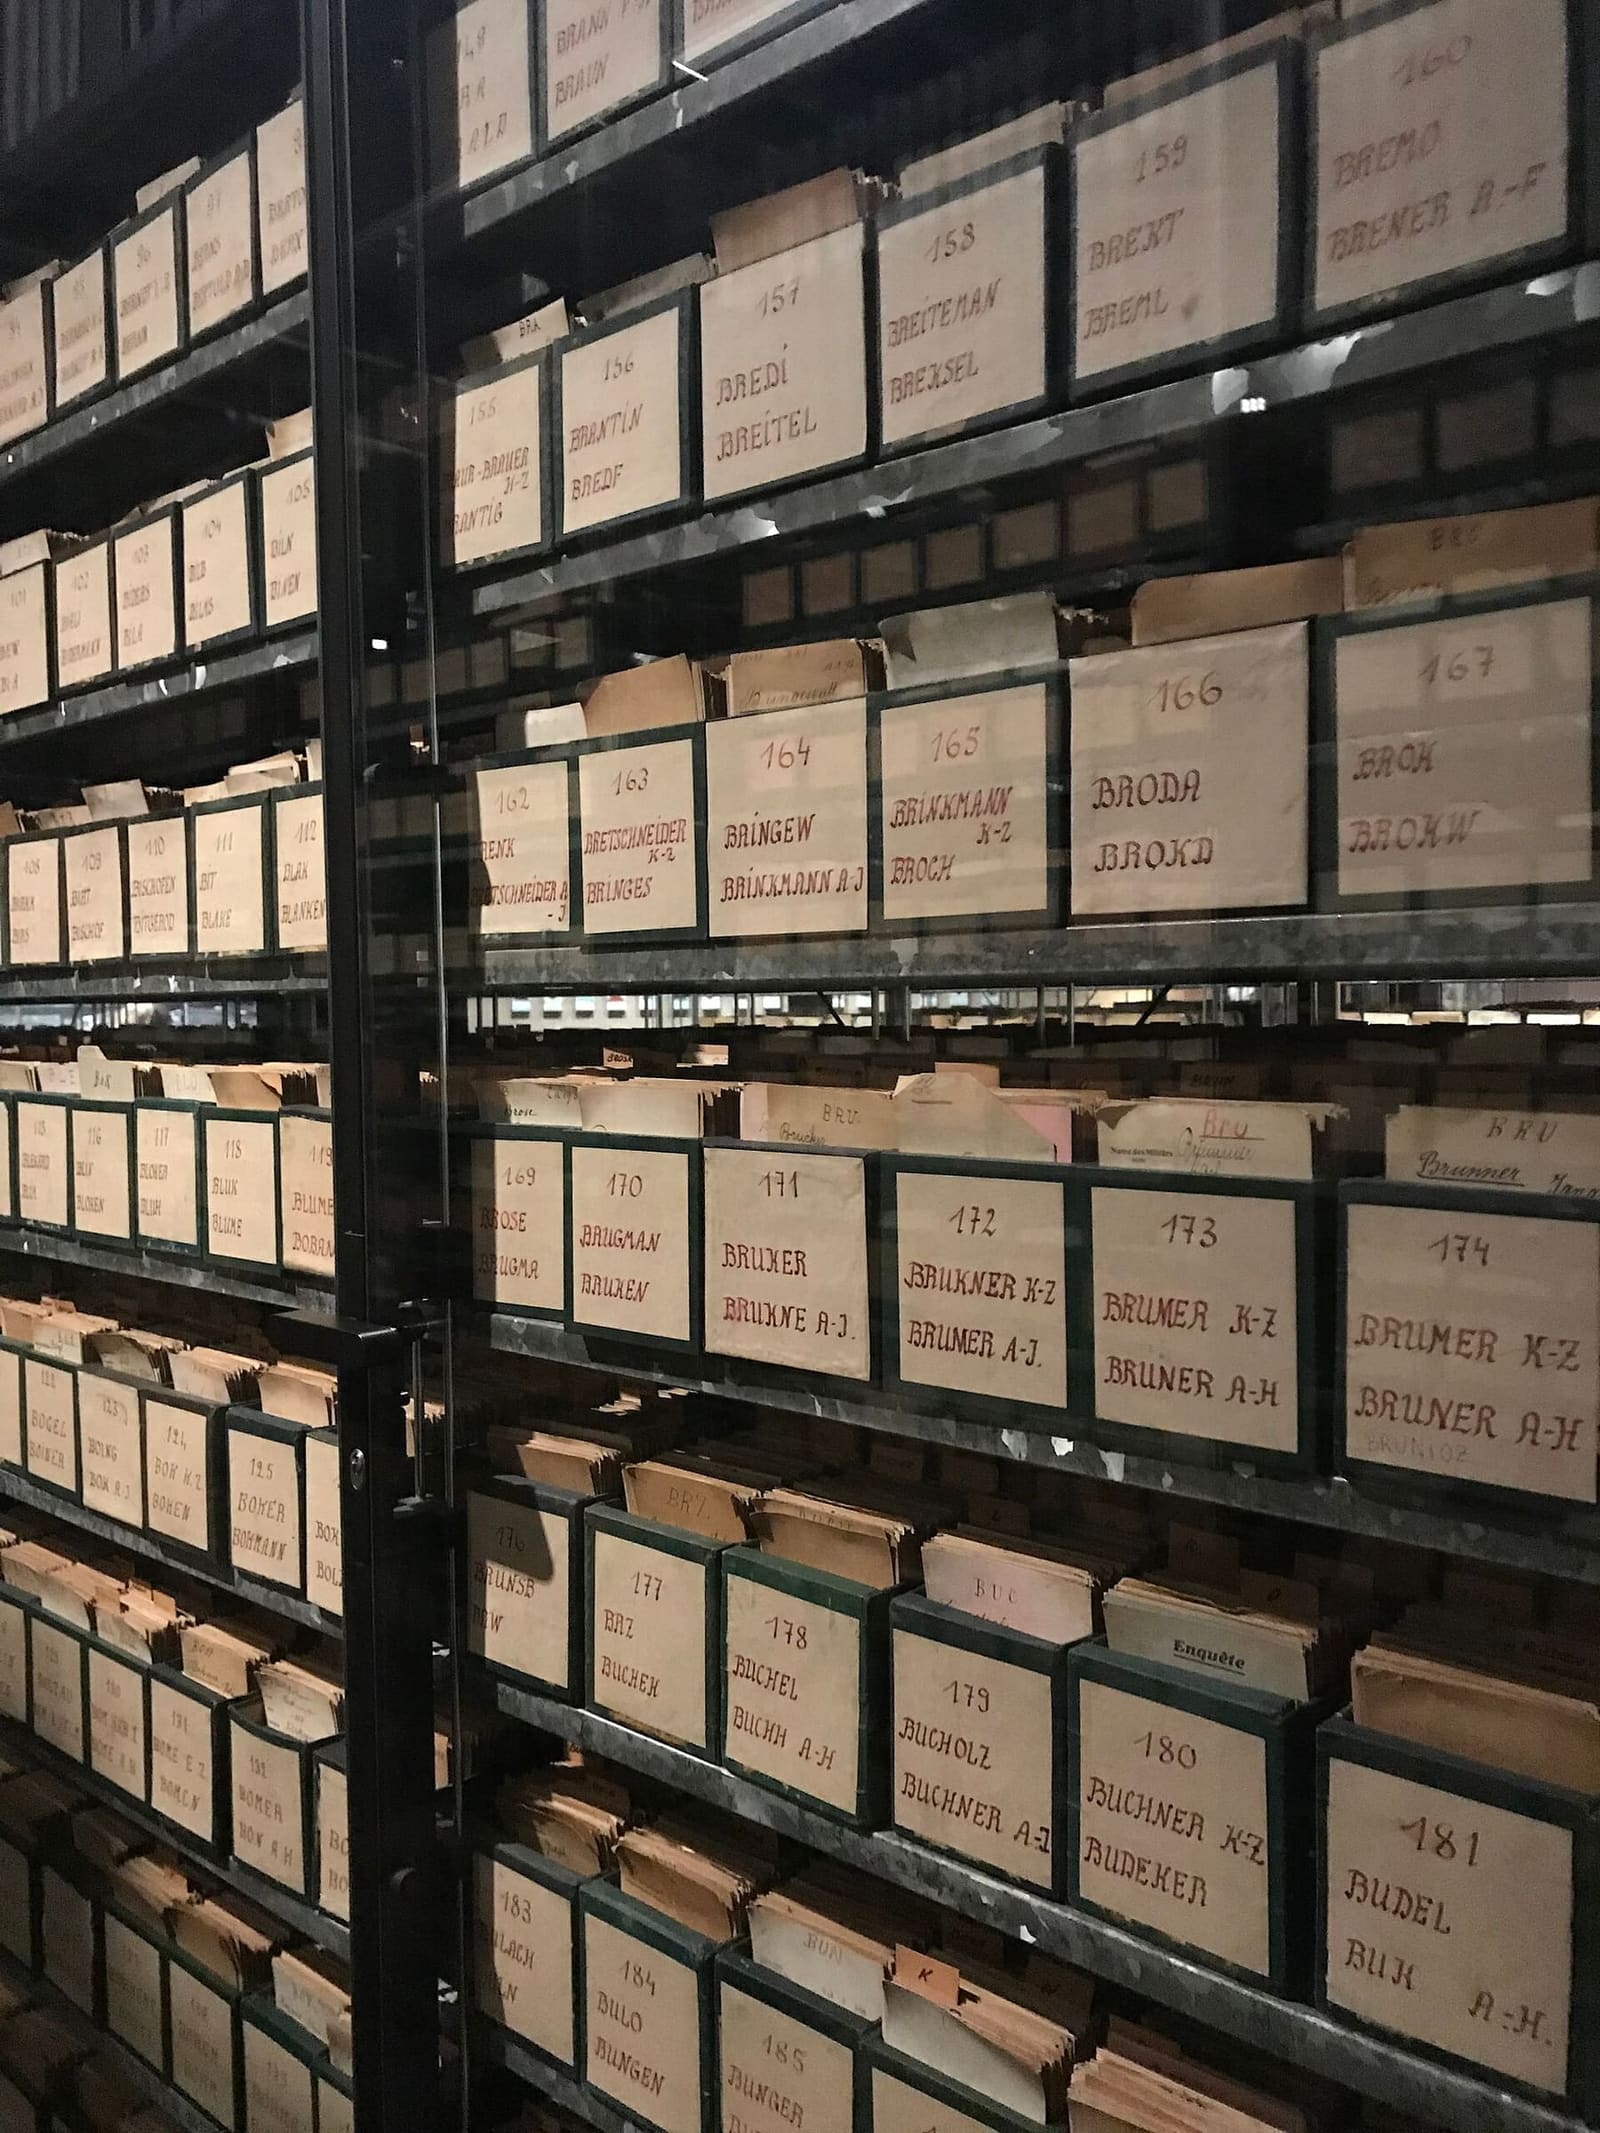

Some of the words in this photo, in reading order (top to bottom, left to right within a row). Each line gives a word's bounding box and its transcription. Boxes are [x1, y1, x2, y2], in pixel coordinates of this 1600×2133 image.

[1133, 132, 1191, 184] 159
[926, 222, 976, 264] 158
[756, 276, 800, 318] 157
[519, 320, 541, 338] BRA
[603, 353, 634, 382] 156
[470, 397, 496, 425] 155
[1416, 645, 1496, 686] 167
[1148, 669, 1224, 714] 166
[758, 736, 812, 771] 164
[931, 725, 982, 764] 165
[614, 767, 649, 797] 163
[1090, 768, 1201, 810] BRODA
[498, 786, 530, 815] 162
[145, 836, 165, 856] 110
[216, 832, 232, 852] 111
[295, 820, 317, 843] 112
[88, 1127, 101, 1145] 116
[154, 1128, 169, 1147] 117
[504, 1166, 537, 1187] 169
[605, 1172, 643, 1199] 170
[758, 1171, 800, 1199] 171
[212, 1214, 242, 1237] BLUME
[579, 1224, 662, 1254] BRUGMAN
[949, 1205, 997, 1237] 172
[1161, 1213, 1218, 1248] 173
[1427, 1232, 1491, 1267] 174
[903, 1260, 1017, 1301] BRUKNER
[1022, 1277, 1056, 1306] K-Z
[1102, 1291, 1210, 1333] BRUMER
[1228, 1303, 1278, 1338] K-Z
[907, 1319, 995, 1358] BRUMER
[1354, 1312, 1499, 1365] BRUMER
[1521, 1332, 1581, 1373] K-Z
[1104, 1355, 1215, 1400] BRUNER
[1224, 1375, 1281, 1408] A-H
[1354, 1385, 1498, 1440] BRUNER
[1515, 1411, 1584, 1453] A-H
[250, 1458, 274, 1481] 125
[630, 1571, 665, 1602] 177
[603, 1608, 635, 1641] BRZ
[765, 1615, 809, 1651] 178
[1172, 1638, 1246, 1671] Enquête
[732, 1653, 799, 1702] BUCHEL
[942, 1678, 991, 1714] 179
[798, 1737, 837, 1772] A-H
[898, 1716, 993, 1771] BUCHOLZ
[1133, 1730, 1198, 1771] 180
[900, 1771, 1004, 1834] BUCHNER
[1087, 1775, 1205, 1843] BUCHNER
[1220, 1824, 1267, 1867] K-Z
[1399, 1816, 1481, 1868] 181
[1083, 1835, 1208, 1908] BUDEKER
[504, 1891, 533, 1925] 183
[1344, 1868, 1452, 1936] BUDEL
[622, 1959, 657, 1997] 184
[918, 1967, 934, 1983] K
[597, 1990, 643, 2033] BULO
[595, 2035, 666, 2096] BUNGEN
[762, 2033, 809, 2074] 185
[727, 2063, 804, 2129] BUNGER
